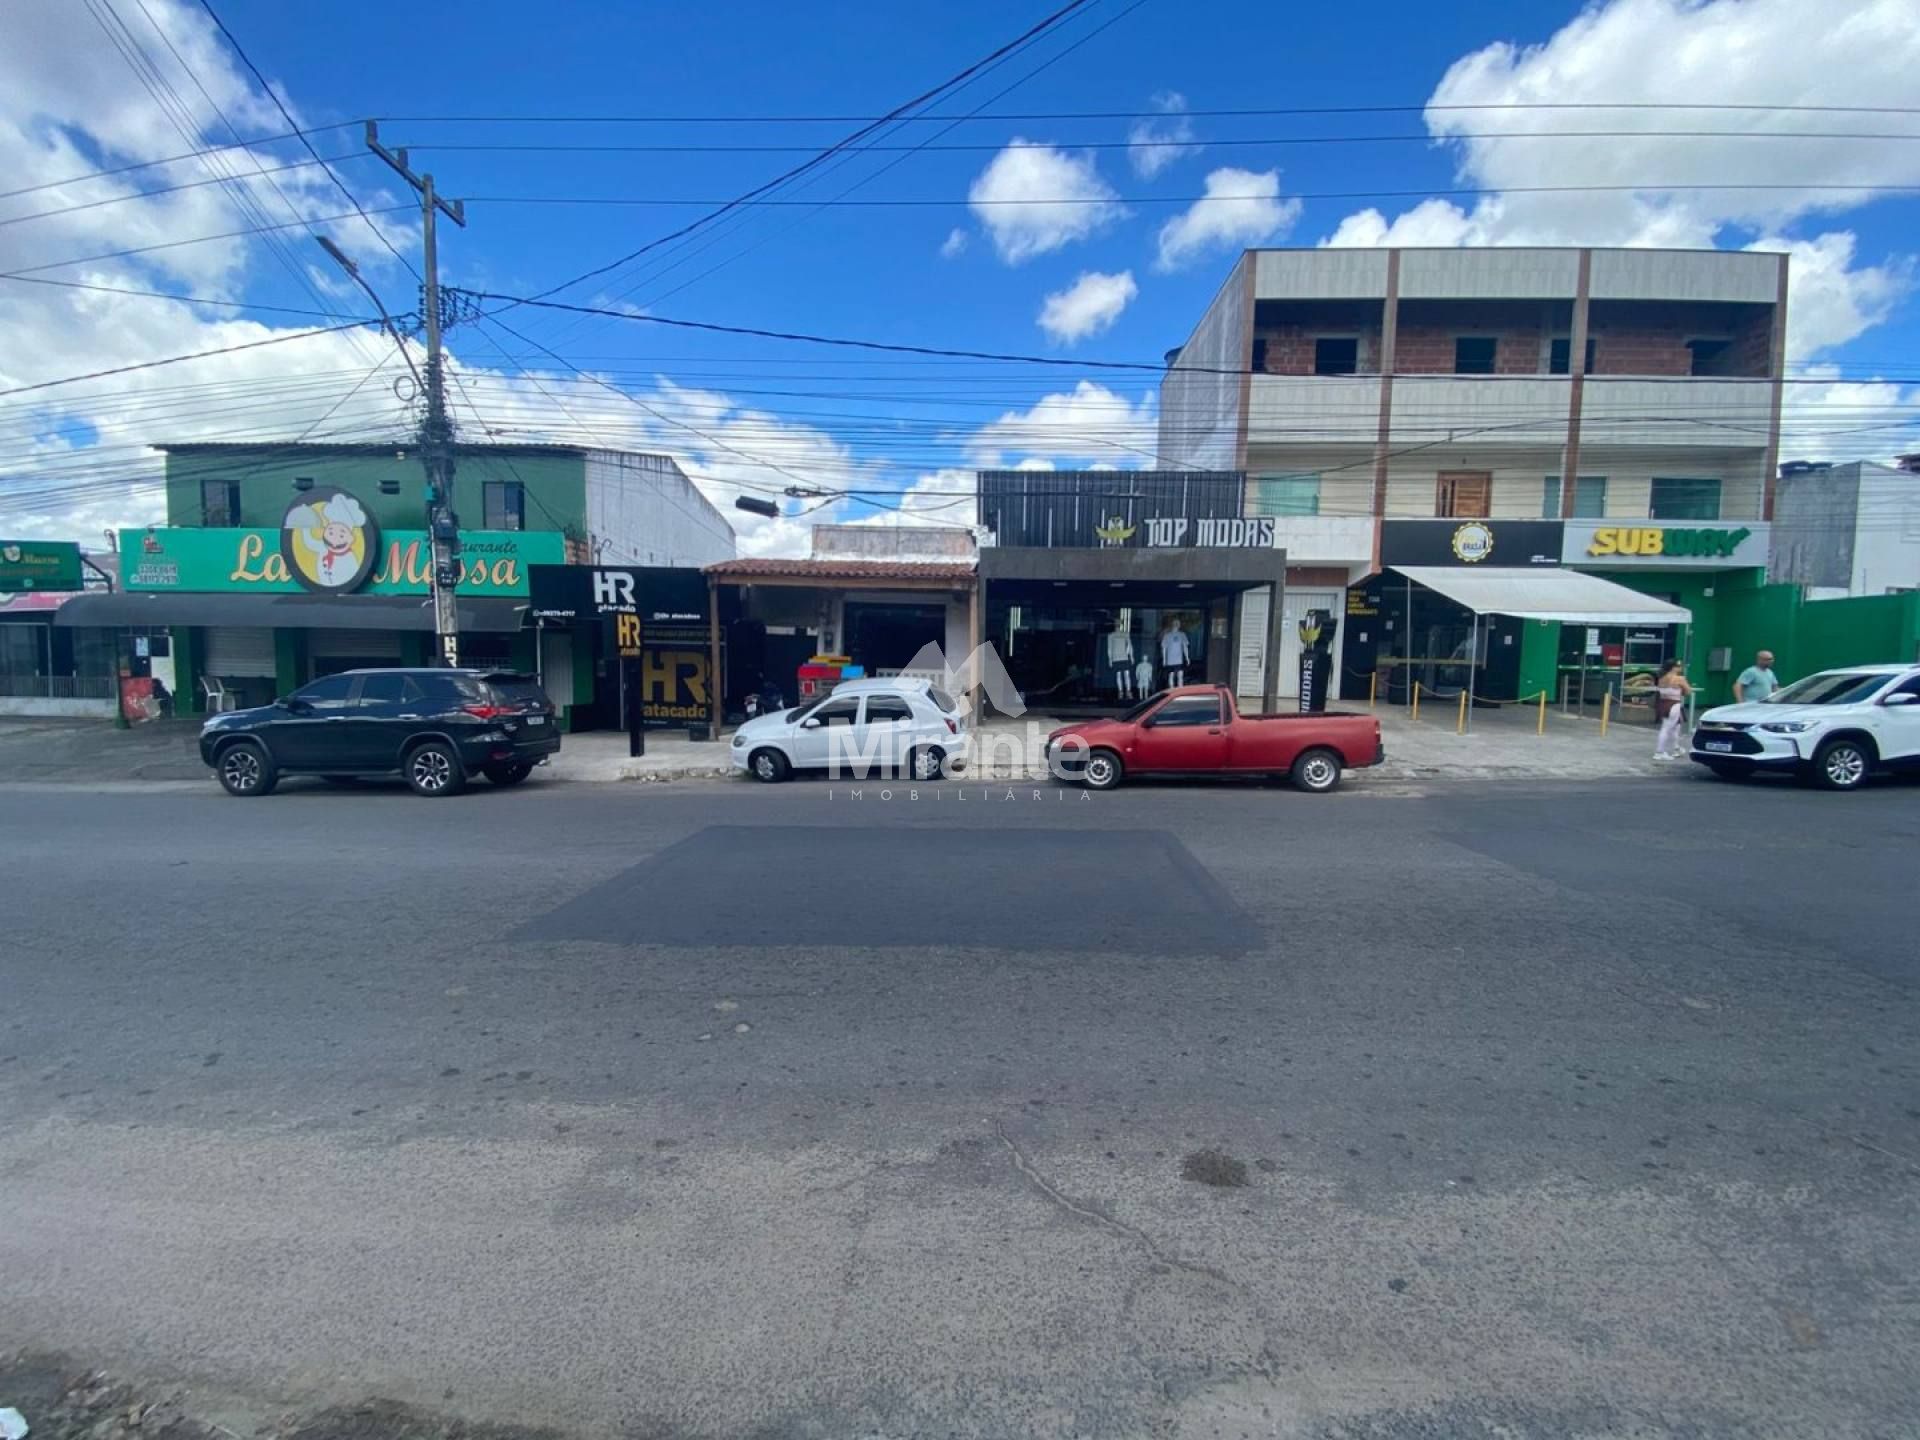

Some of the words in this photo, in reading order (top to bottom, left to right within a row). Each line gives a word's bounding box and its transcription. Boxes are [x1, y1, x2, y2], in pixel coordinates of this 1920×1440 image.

[1144, 518, 1188, 547] TOP
[1196, 518, 1274, 547] MODAS
[1588, 527, 1752, 556] SUBWAY
[230, 534, 293, 582] La
[593, 571, 636, 604] HR
[617, 614, 641, 647] HR
[642, 651, 706, 703] HR
